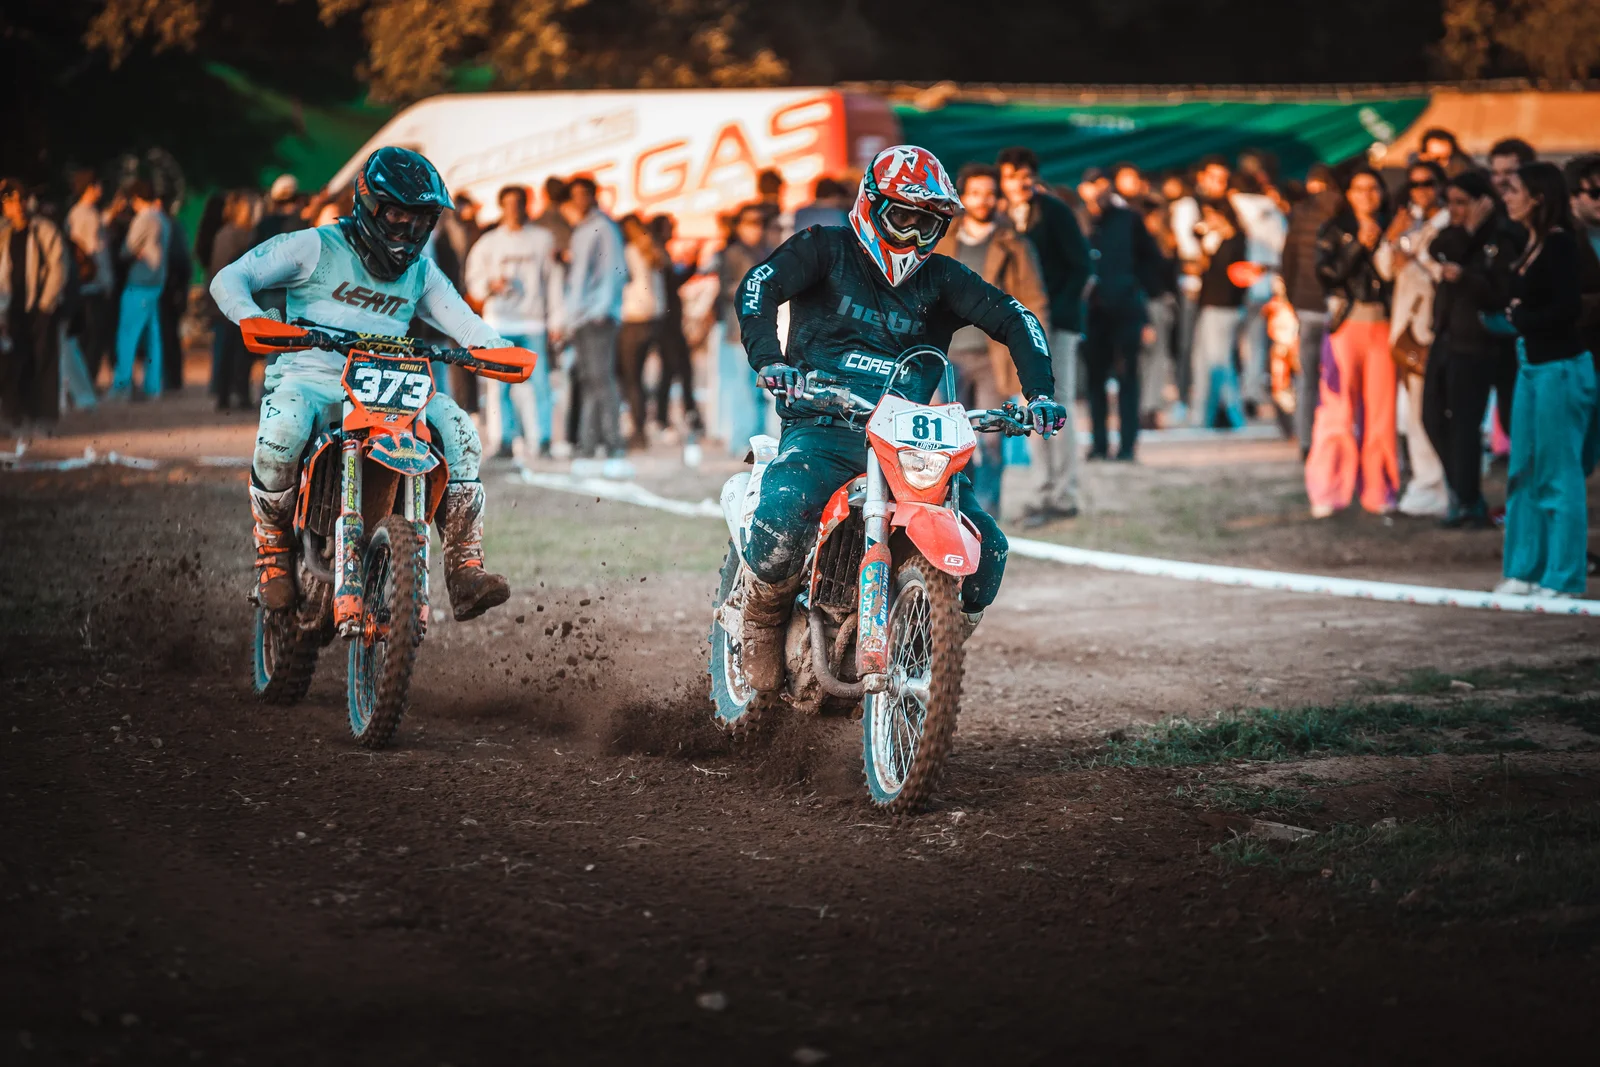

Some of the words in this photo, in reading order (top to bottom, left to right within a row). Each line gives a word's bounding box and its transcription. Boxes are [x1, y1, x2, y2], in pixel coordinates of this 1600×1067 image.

[331, 281, 409, 316] LEATT
[352, 368, 431, 408] 373
[912, 415, 942, 442] 81
